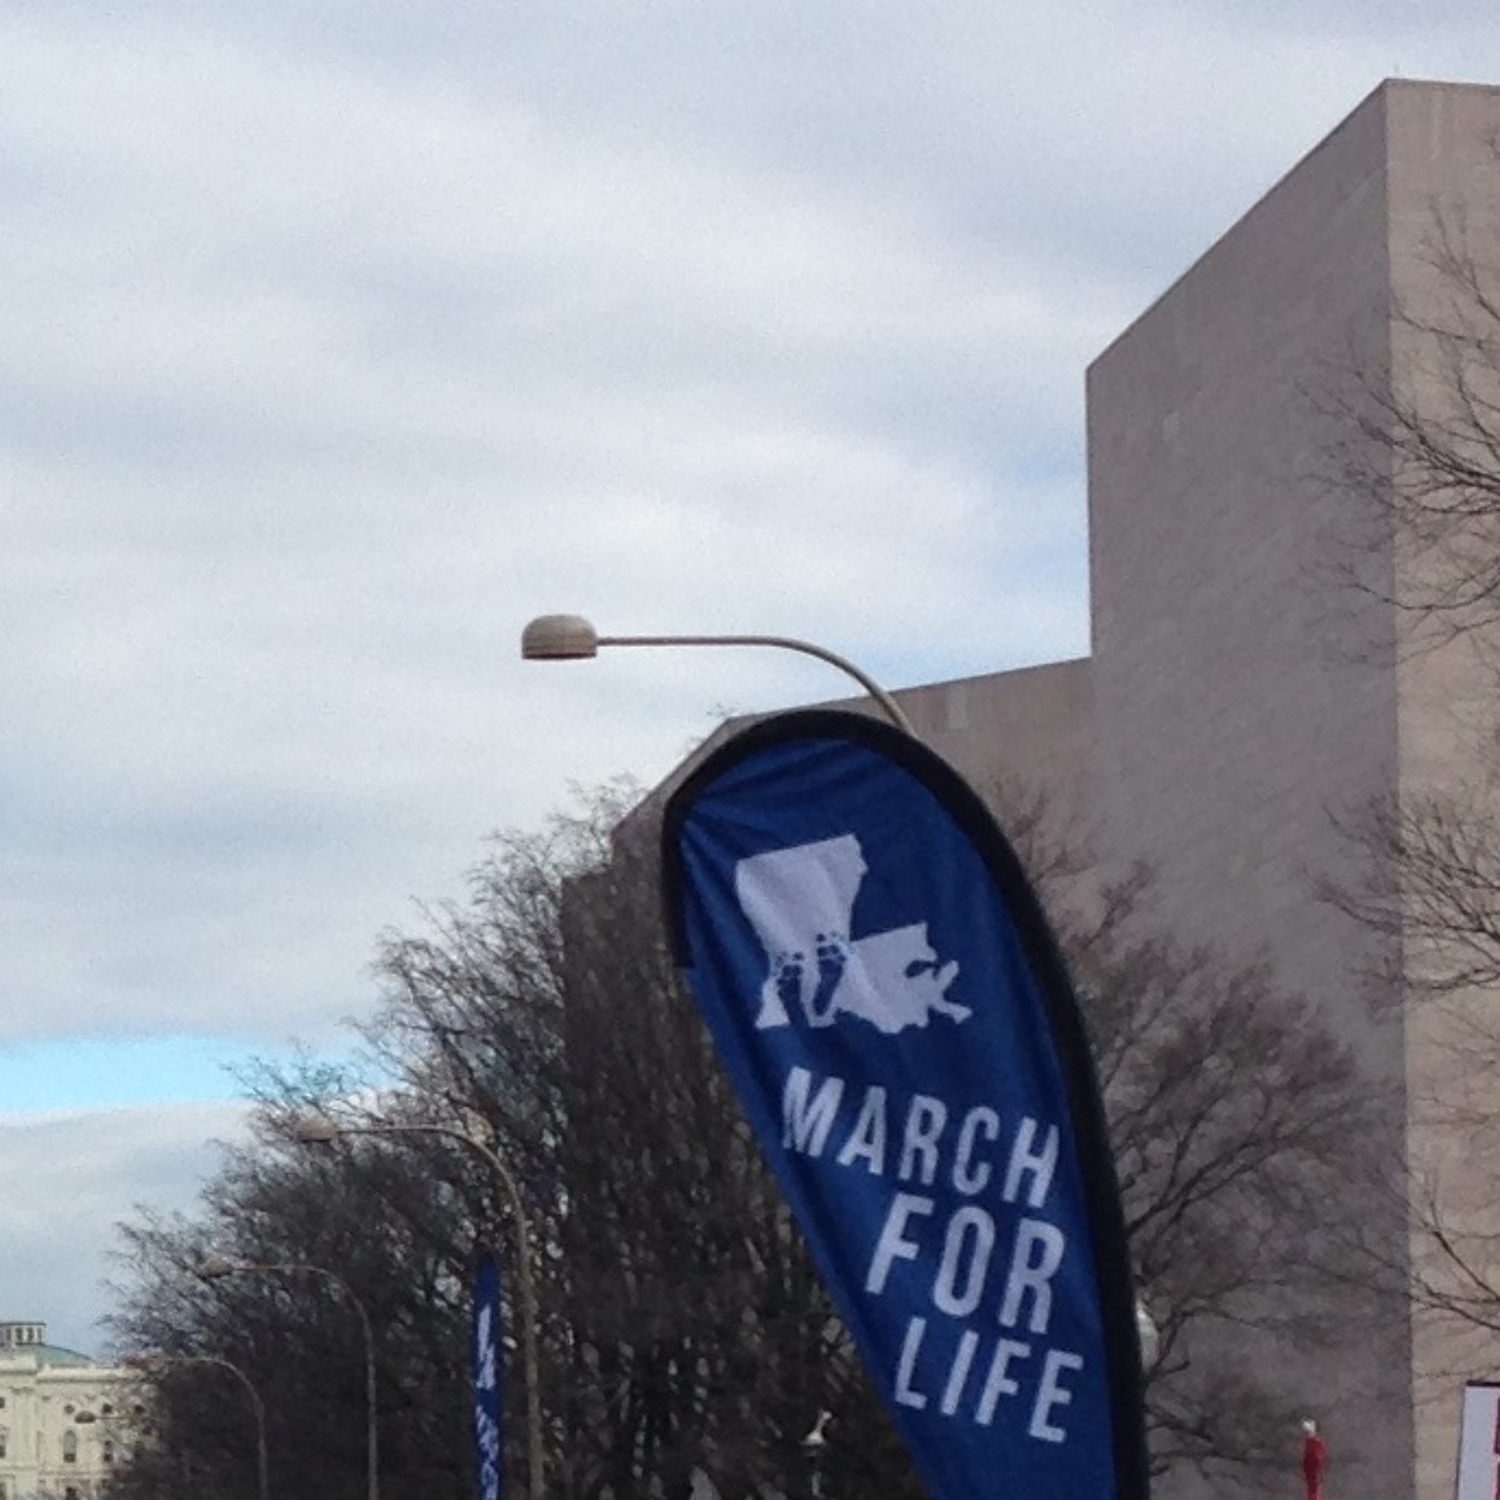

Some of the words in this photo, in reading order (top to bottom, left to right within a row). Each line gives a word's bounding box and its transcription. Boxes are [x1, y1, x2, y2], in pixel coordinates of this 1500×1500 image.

[781, 1066, 1060, 1208] MARCH
[866, 1193, 1065, 1334] FOR
[895, 1317, 1084, 1443] LIFE
